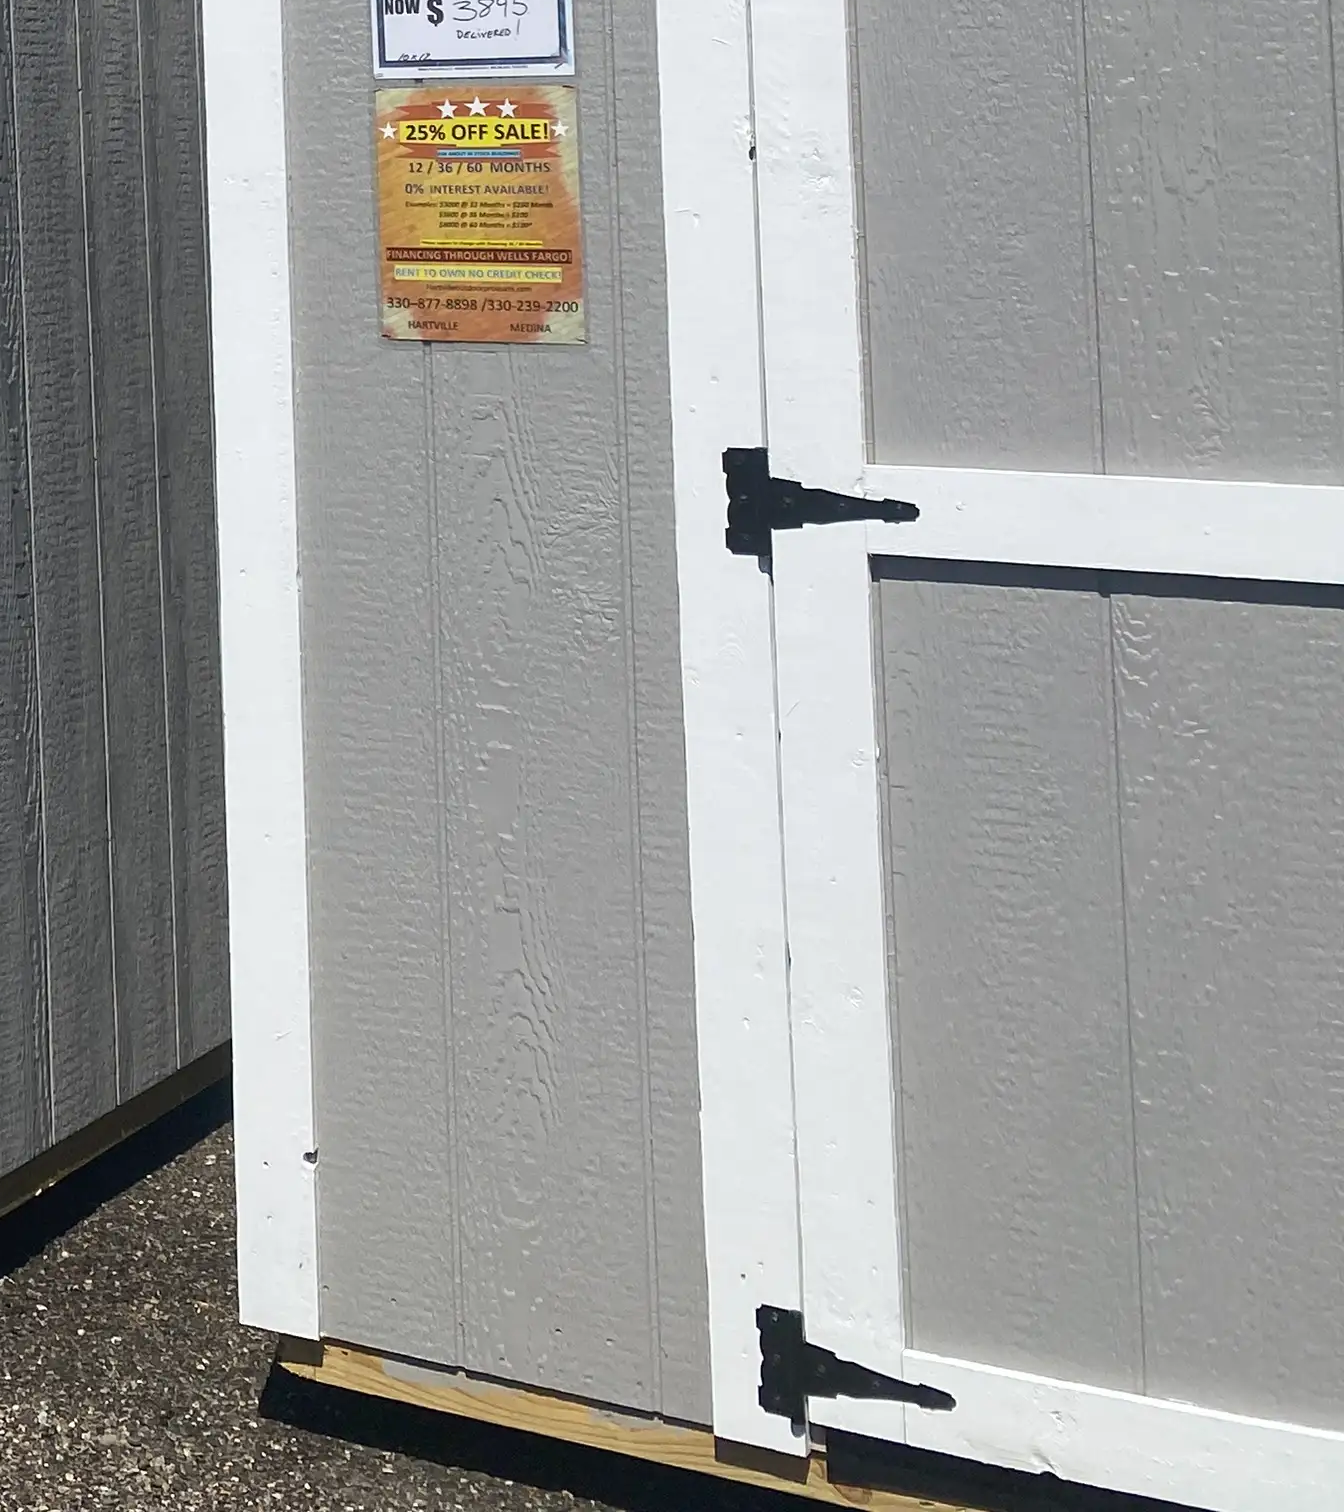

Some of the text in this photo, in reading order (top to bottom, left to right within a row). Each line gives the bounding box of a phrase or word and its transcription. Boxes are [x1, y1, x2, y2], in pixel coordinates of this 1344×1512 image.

[405, 122, 549, 141] 25% OFF SALE!
[408, 162, 551, 175] 12 / 36 / 60 MONTHS
[405, 183, 549, 195] 0% INTEREST AVAILABLE!
[386, 250, 572, 262] FINANCING THROUGH WELLS FARGO!
[395, 268, 561, 279] RENT TO OWN NO CREDIT CHECK!
[408, 320, 552, 333] HARTVILLE MEDINA
